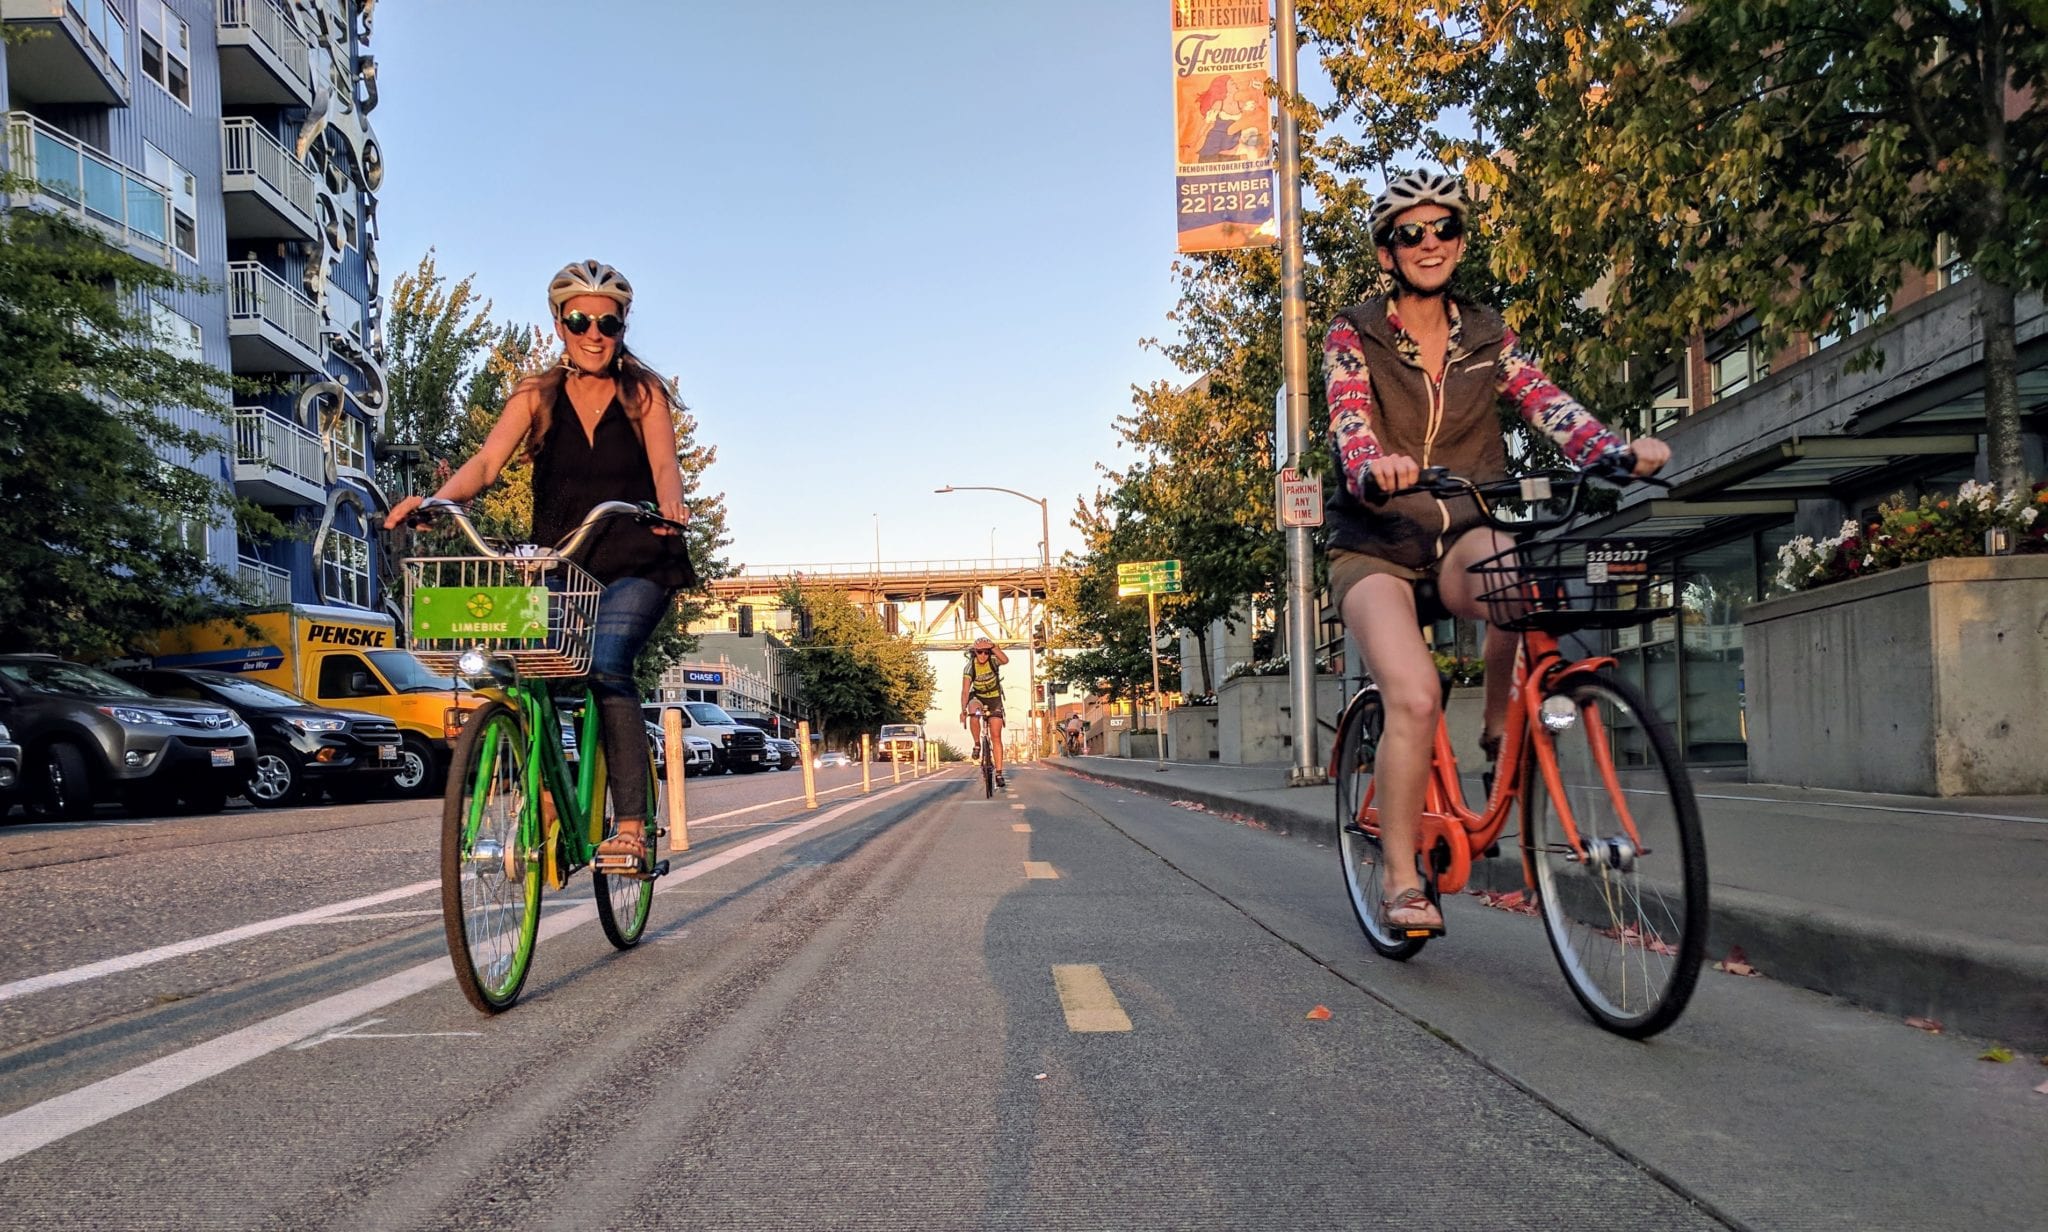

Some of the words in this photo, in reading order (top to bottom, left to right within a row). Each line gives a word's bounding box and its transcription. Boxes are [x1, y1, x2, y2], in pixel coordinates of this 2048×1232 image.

[1176, 9, 1205, 27] BEER
[1209, 6, 1264, 26] FESTIVAL
[1175, 34, 1268, 78] Fremont
[1197, 62, 1265, 72] OKTOBERFEST
[1178, 160, 1270, 174] FREMONTOKTOBERFEST.COM
[1181, 178, 1270, 195] SEPTEMBER
[1286, 485, 1317, 495] PARKING
[1295, 498, 1309, 506] ANY
[1294, 510, 1312, 518] TIME
[1587, 550, 1649, 562] 3282077
[451, 622, 508, 633] LIMEBIKE
[308, 625, 386, 647] PENSKE
[690, 673, 713, 681] CHASE
